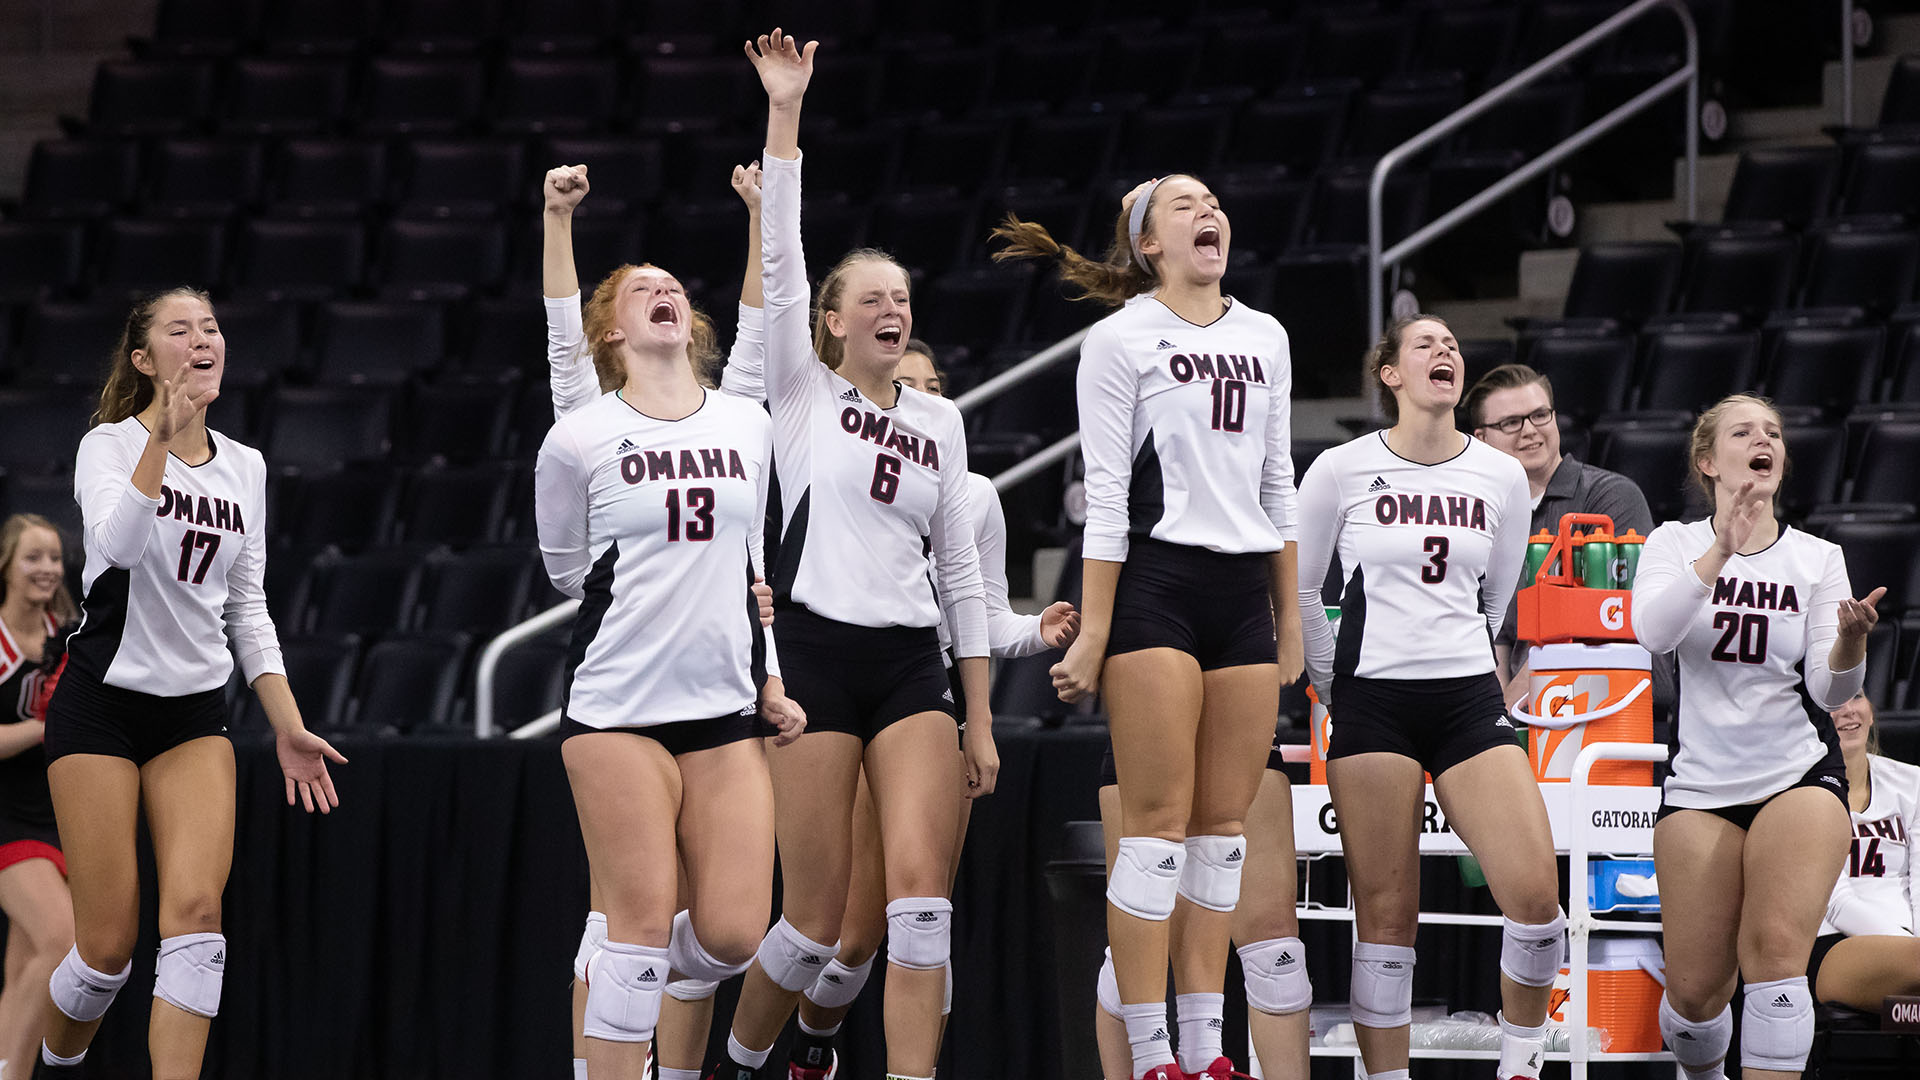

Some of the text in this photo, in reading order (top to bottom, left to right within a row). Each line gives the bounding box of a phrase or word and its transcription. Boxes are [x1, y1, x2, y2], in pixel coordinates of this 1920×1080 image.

[1169, 353, 1267, 385] OMAHA
[1210, 377, 1247, 433] 10
[840, 406, 940, 472] OMAHA
[620, 447, 747, 485] OMAHA
[870, 452, 902, 505] 6
[665, 487, 715, 542] 13
[1375, 494, 1486, 531] OMAHA
[176, 529, 221, 585] 17
[1421, 536, 1449, 584] 3
[1599, 597, 1624, 631] G
[1712, 576, 1800, 613] MAHA
[1711, 611, 1769, 665] 20
[1849, 838, 1886, 878] 14
